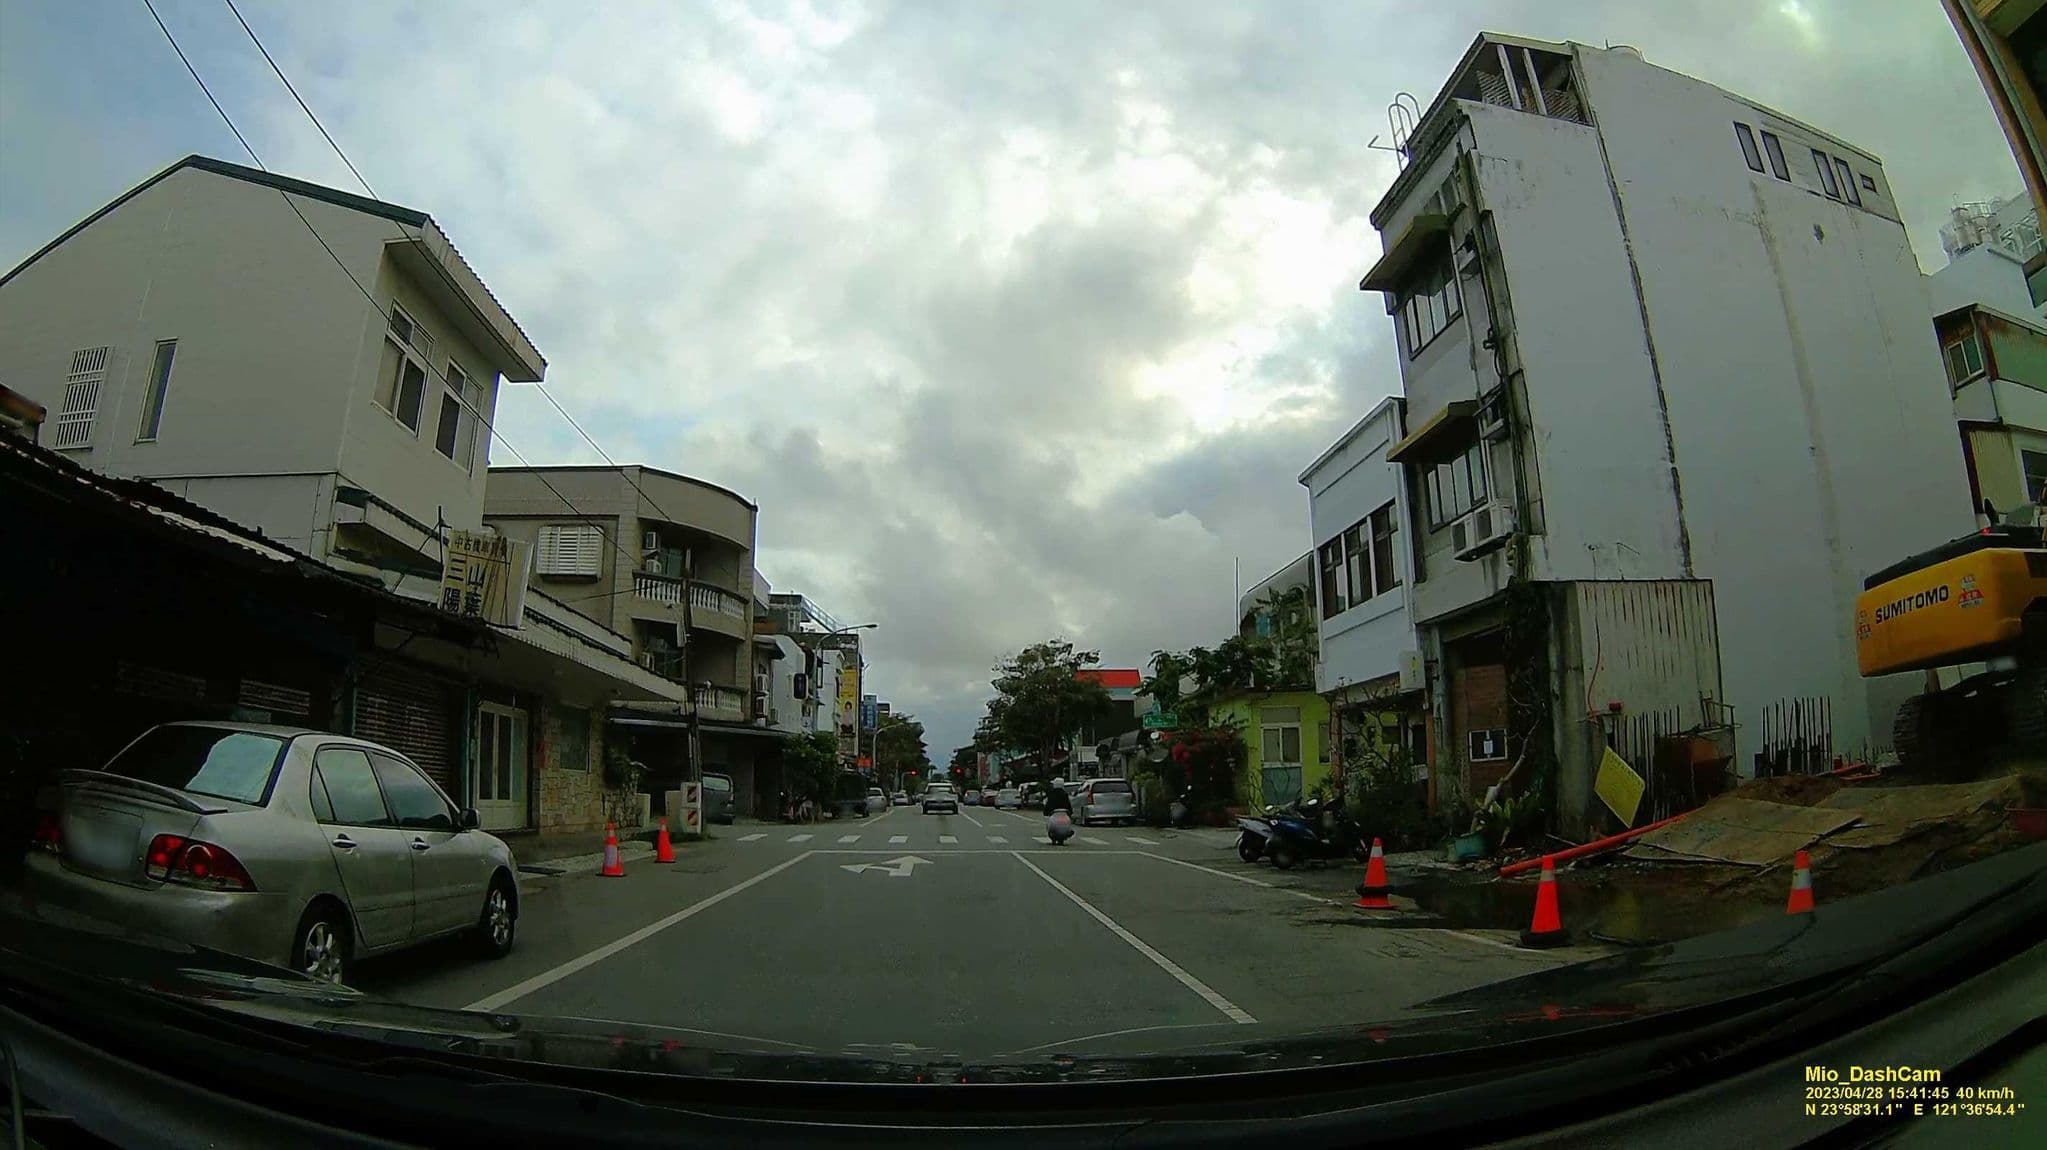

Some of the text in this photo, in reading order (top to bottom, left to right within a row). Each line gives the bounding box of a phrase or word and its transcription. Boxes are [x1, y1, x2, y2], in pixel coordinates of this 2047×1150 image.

[454, 533, 510, 559] 中古機車
[1875, 585, 1949, 625] SUMITOMO
